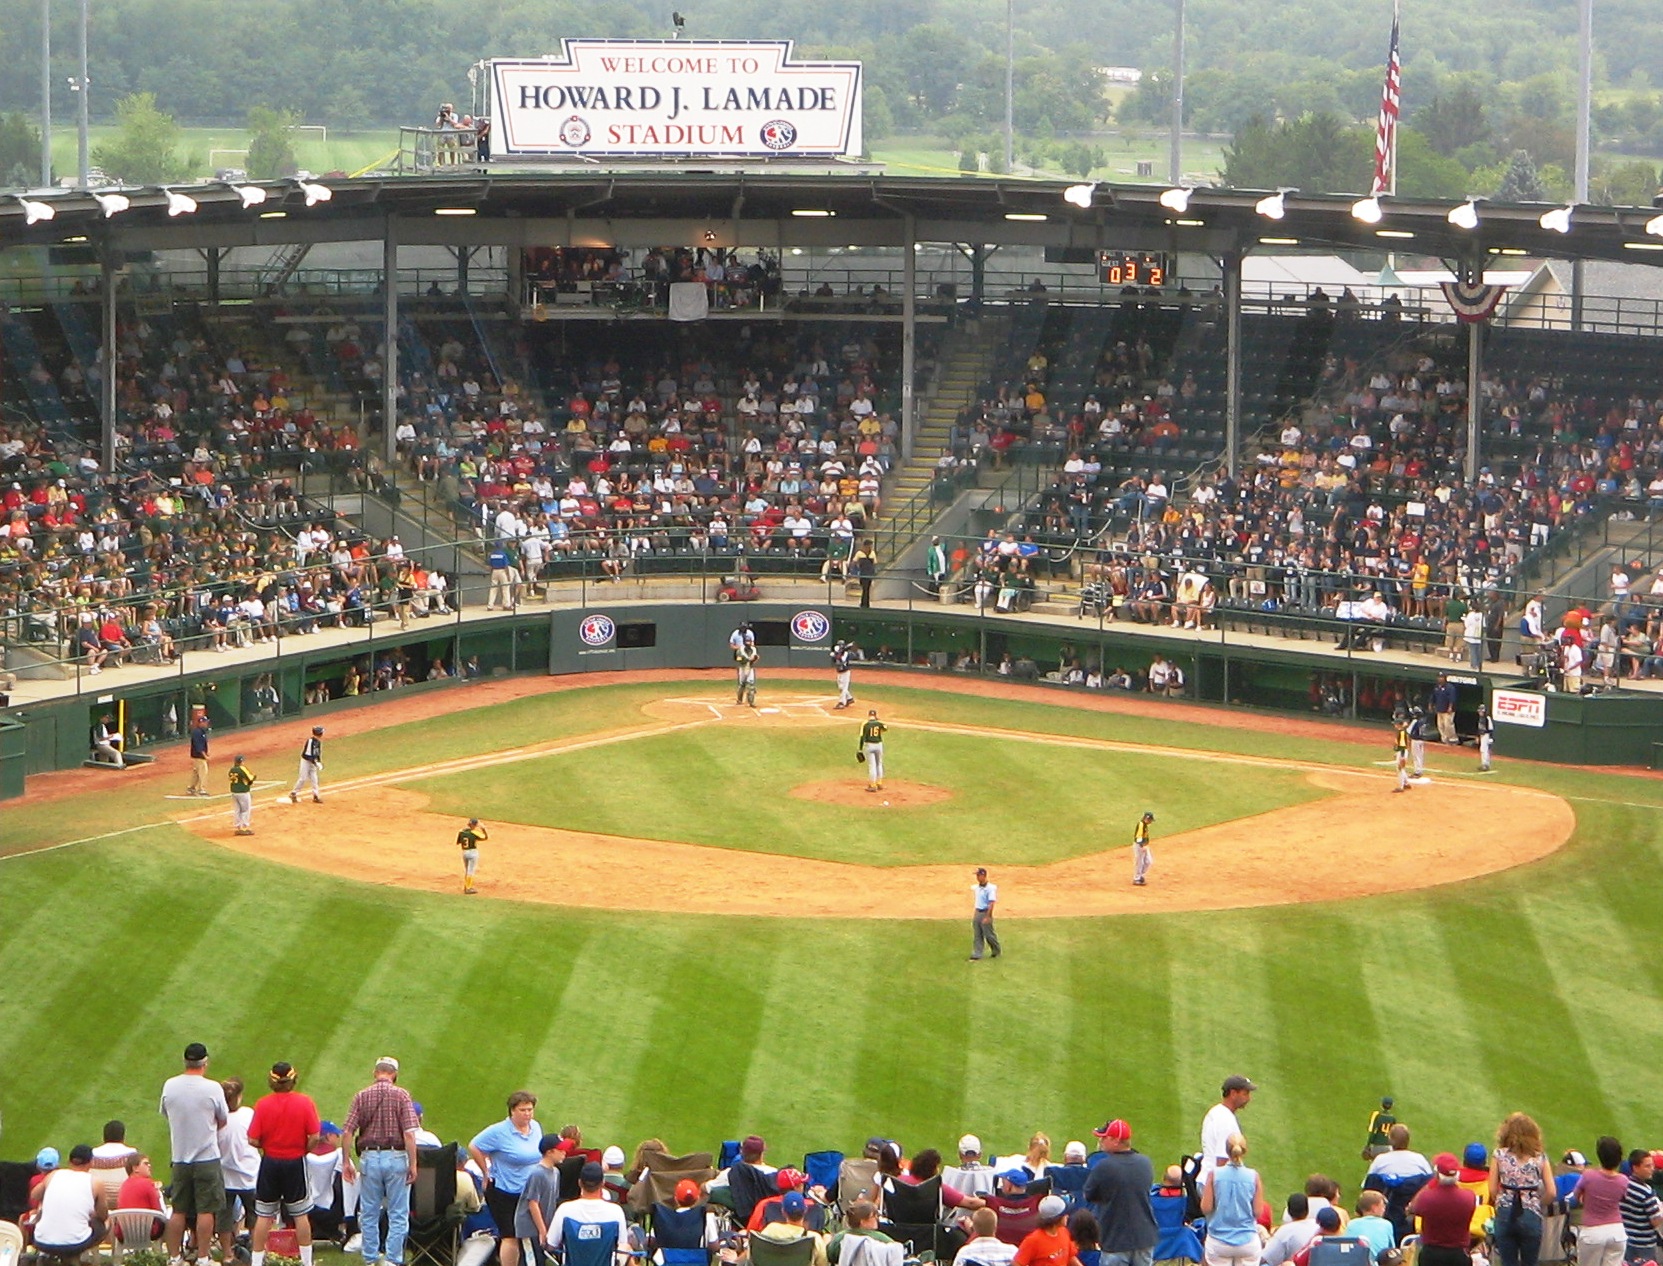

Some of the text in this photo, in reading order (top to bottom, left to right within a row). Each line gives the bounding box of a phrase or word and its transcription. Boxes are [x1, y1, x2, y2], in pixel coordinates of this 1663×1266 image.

[600, 57, 759, 74] WELCOME TO
[518, 85, 837, 120] HOWARD J. LAMADE
[607, 124, 745, 145] STADIUM
[1110, 266, 1121, 284] 0
[1125, 262, 1136, 280] 3
[1150, 267, 1161, 285] 2
[1497, 696, 1540, 714] ESPN
